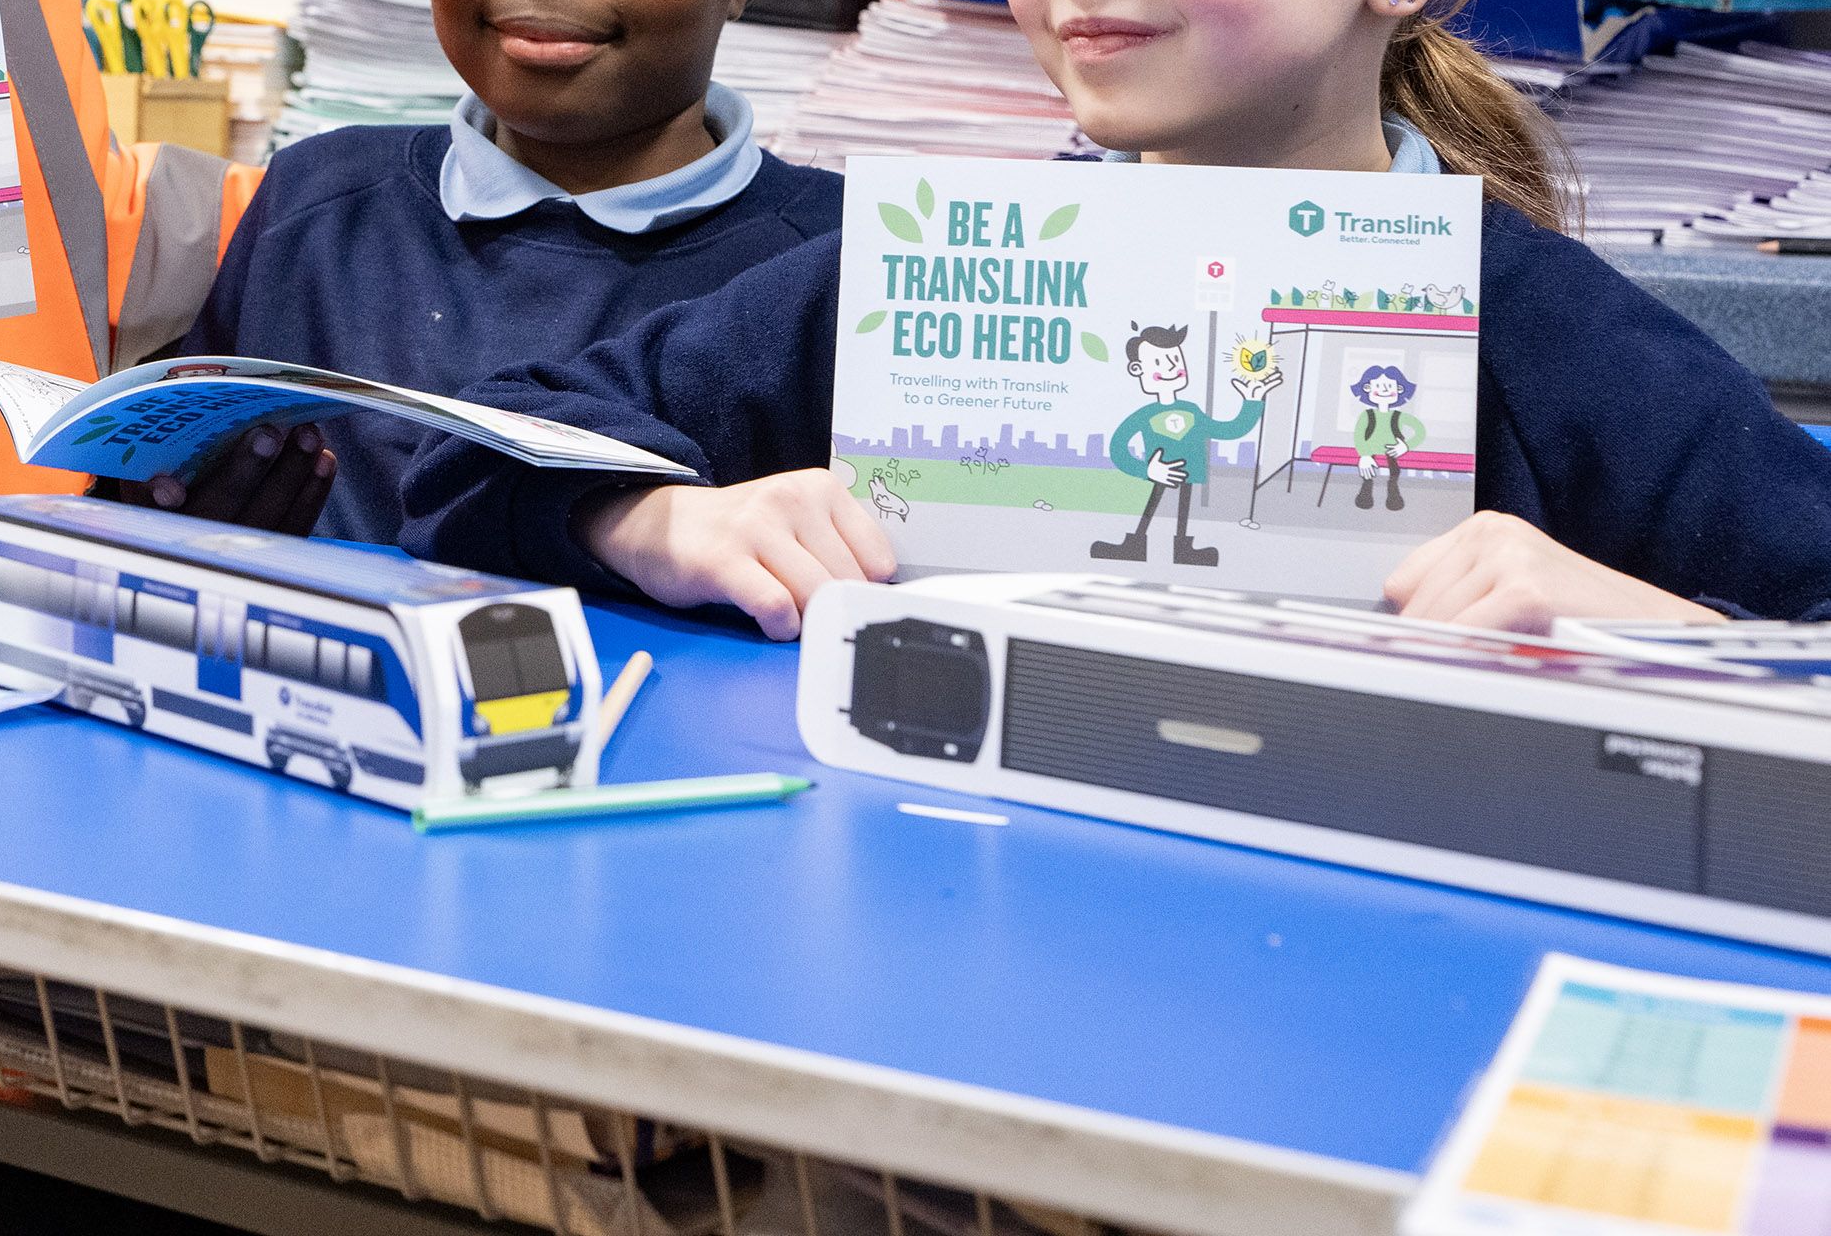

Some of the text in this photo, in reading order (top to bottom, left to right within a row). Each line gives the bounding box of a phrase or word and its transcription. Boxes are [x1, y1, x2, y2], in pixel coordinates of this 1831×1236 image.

[947, 201, 1025, 248] BE A
[1335, 211, 1452, 236] Translink
[1339, 235, 1420, 246] Better. Connected
[882, 254, 1089, 308] TRANSLINK
[892, 311, 1071, 364] ECO HERO
[890, 373, 1069, 394] Travelling with Translink
[122, 396, 169, 413] BE
[904, 391, 1052, 411] to a Greener Future
[137, 411, 205, 444] ECO
